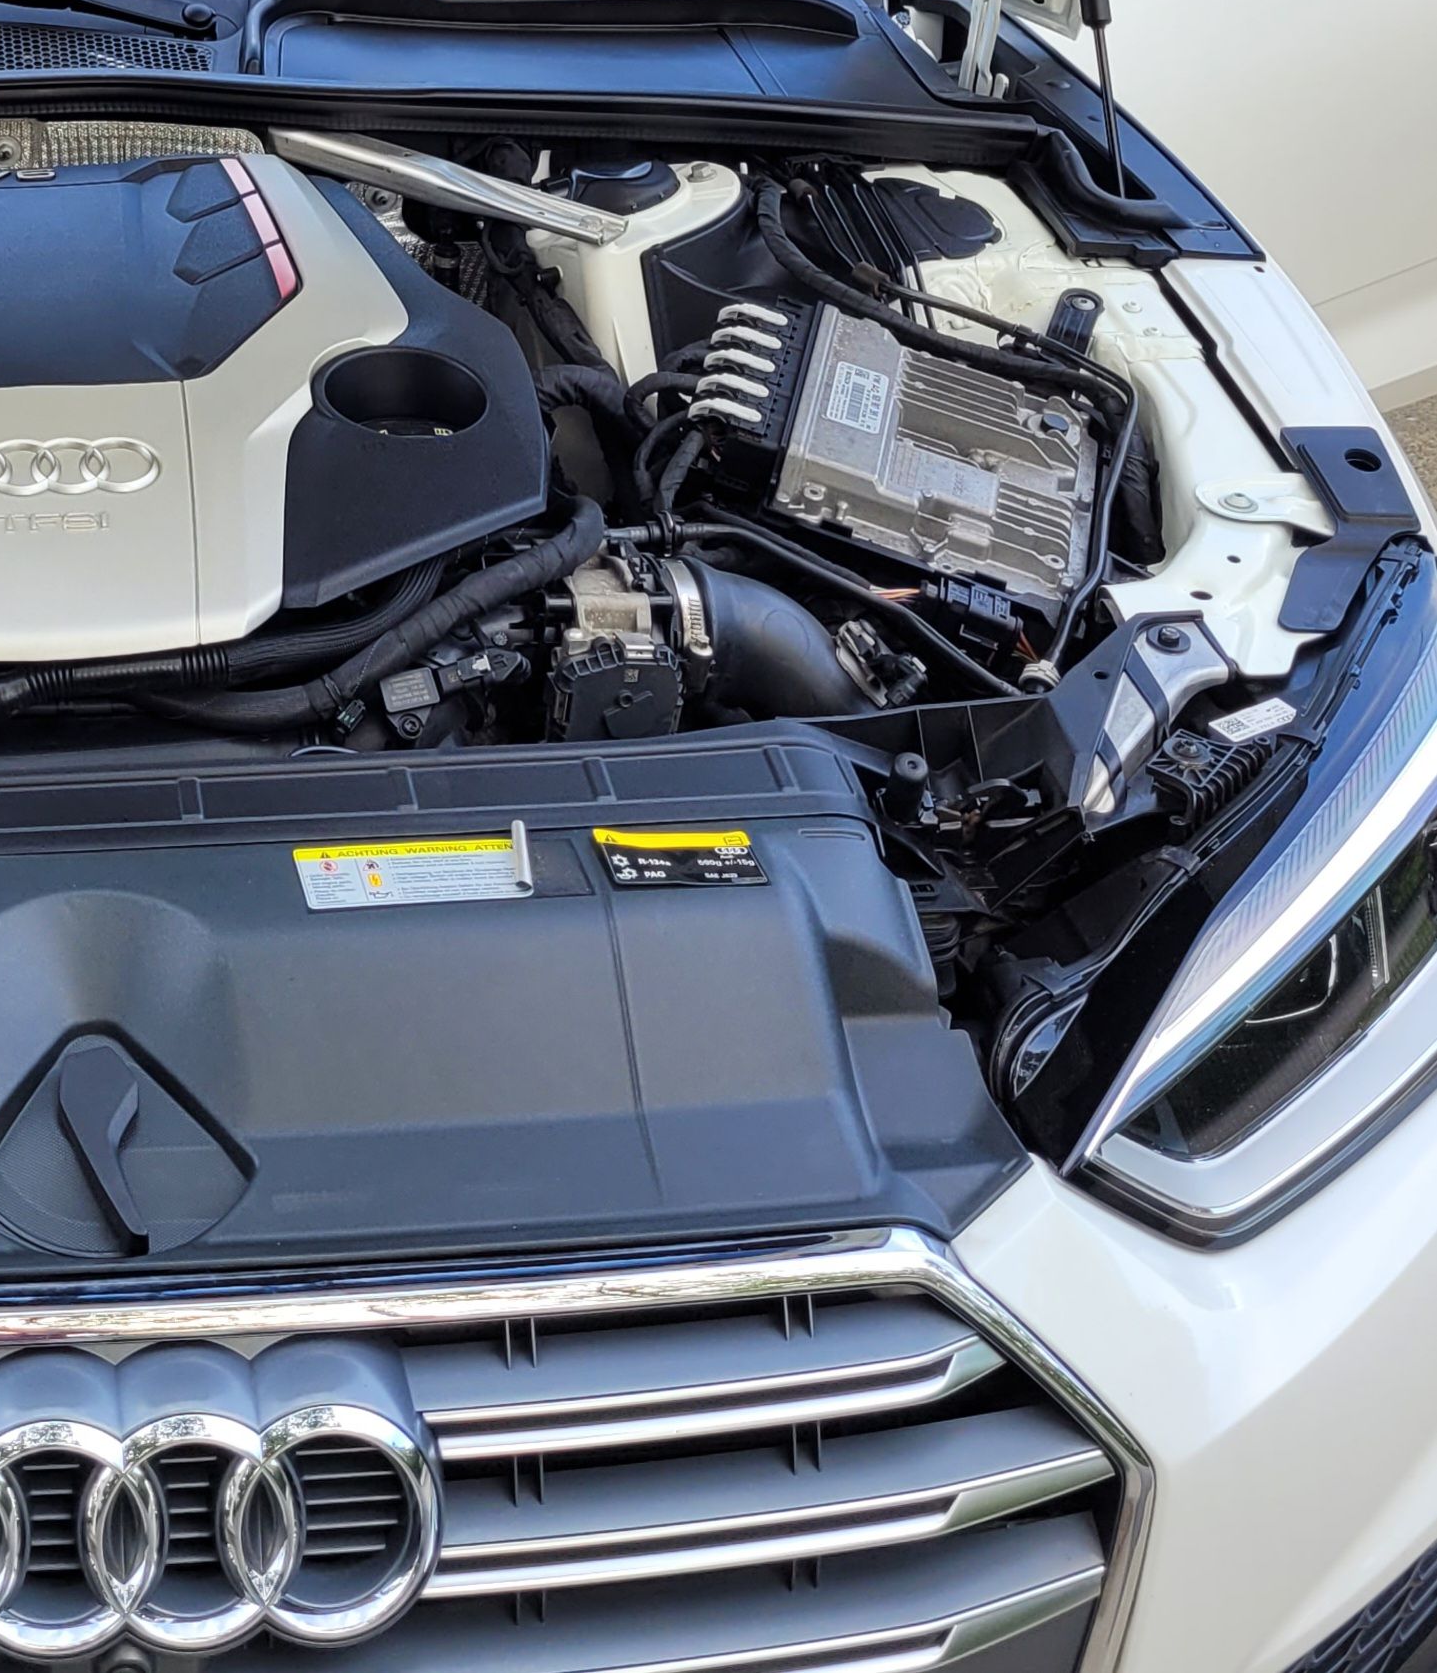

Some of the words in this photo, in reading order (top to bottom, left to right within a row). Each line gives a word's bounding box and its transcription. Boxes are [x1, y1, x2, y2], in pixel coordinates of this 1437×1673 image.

[337, 848, 398, 857] ACHTUNG
[405, 845, 467, 854] WARNING
[643, 870, 667, 879] PAG
